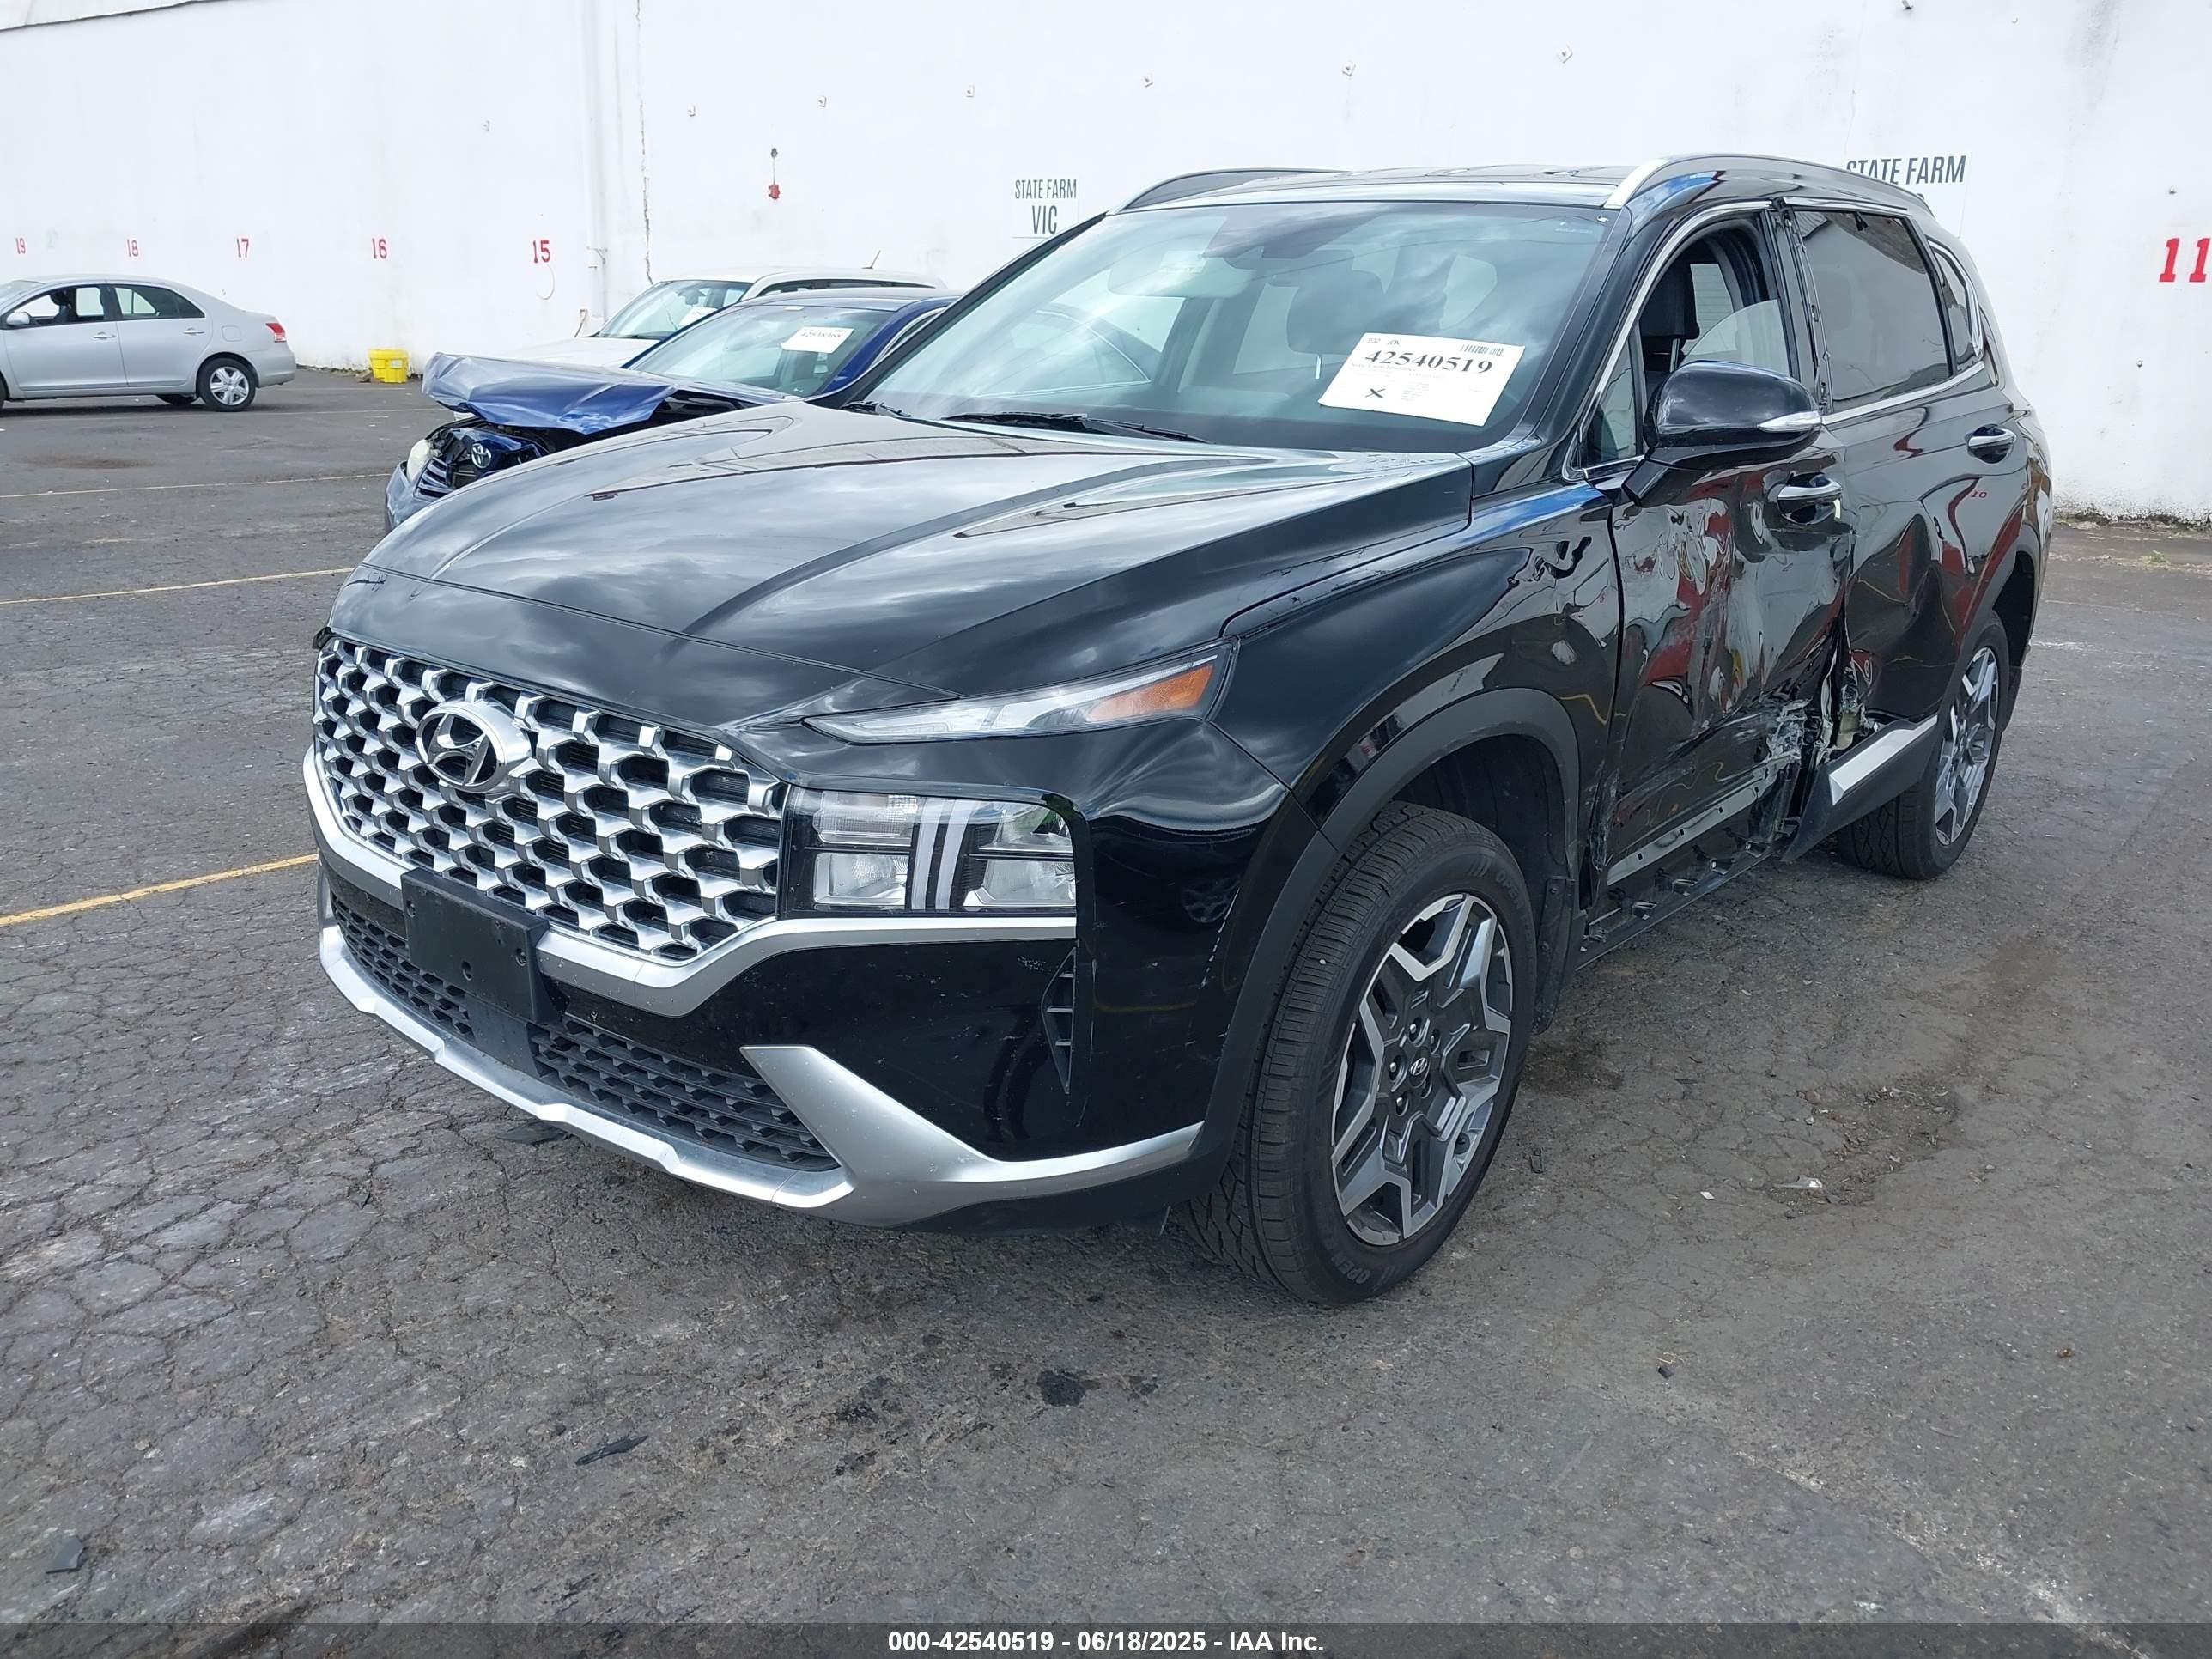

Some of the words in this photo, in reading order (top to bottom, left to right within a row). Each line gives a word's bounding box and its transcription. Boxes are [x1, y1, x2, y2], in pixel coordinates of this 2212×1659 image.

[1905, 155, 1966, 185] FARM
[1015, 179, 1044, 199] STATE
[1046, 179, 1077, 199] FARM
[1031, 205, 1057, 234] VIC
[15, 237, 26, 255] 19
[127, 239, 139, 257] 18
[236, 238, 250, 258] 17
[372, 238, 387, 259] 16
[532, 239, 551, 264] 15
[2159, 237, 2211, 283] 11
[1364, 349, 1493, 374] 42540519
